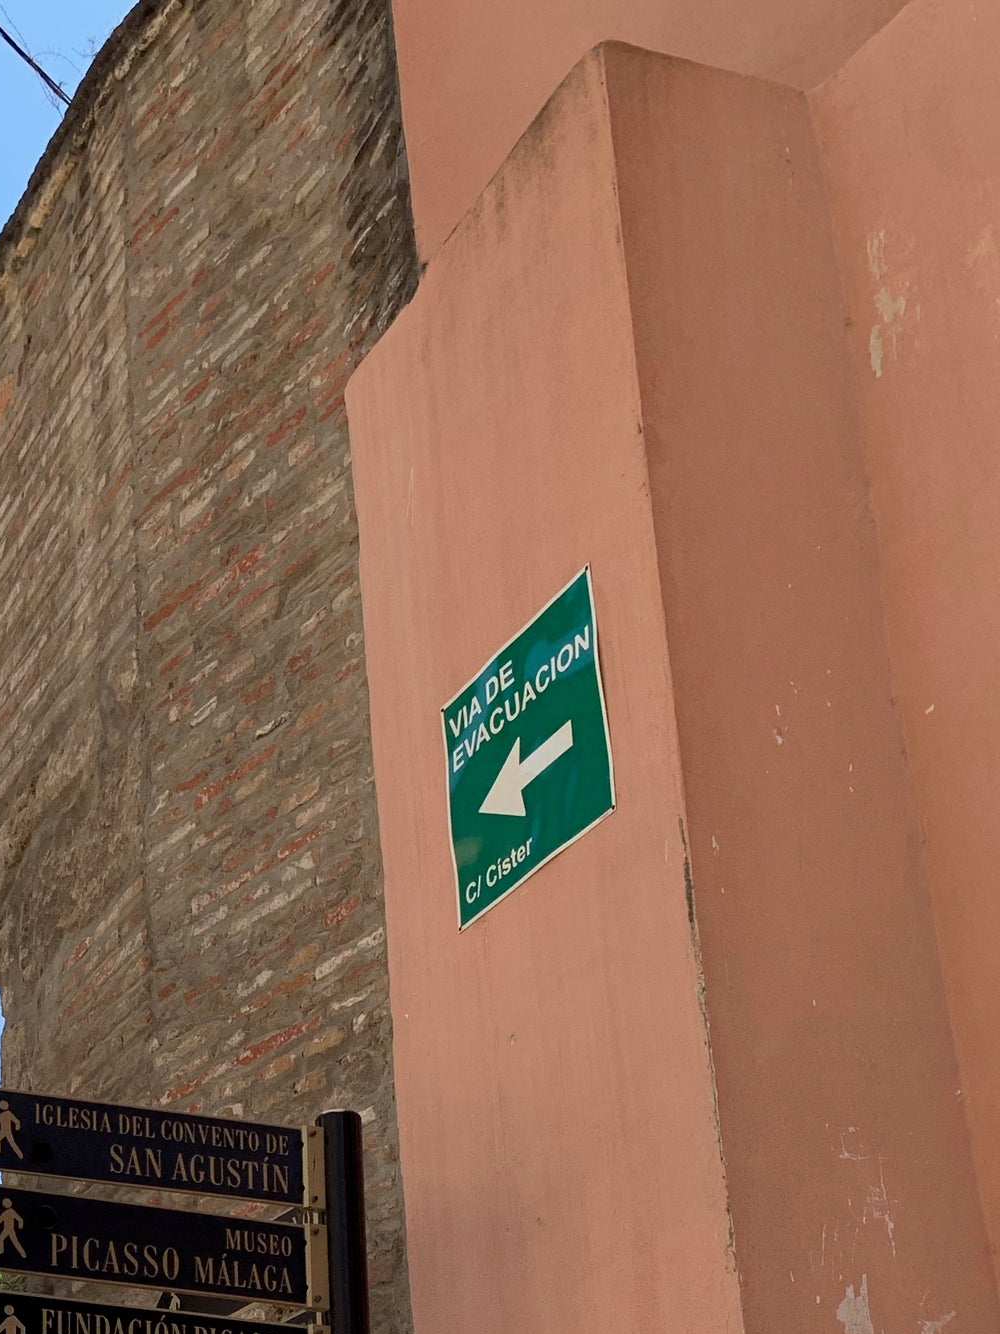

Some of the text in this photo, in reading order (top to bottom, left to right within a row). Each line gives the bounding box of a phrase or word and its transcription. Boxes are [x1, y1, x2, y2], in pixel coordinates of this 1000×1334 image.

[449, 660, 515, 738] VIA DE
[453, 625, 590, 773] EVACUACION
[466, 875, 481, 904] C/
[34, 1103, 290, 1156] IGLESIA DEL CONVENTO DE
[109, 1144, 290, 1194] SAN AGUSTÍN
[50, 1233, 294, 1294] PICASSO MÁLAGA
[225, 1228, 292, 1257] MUSEO
